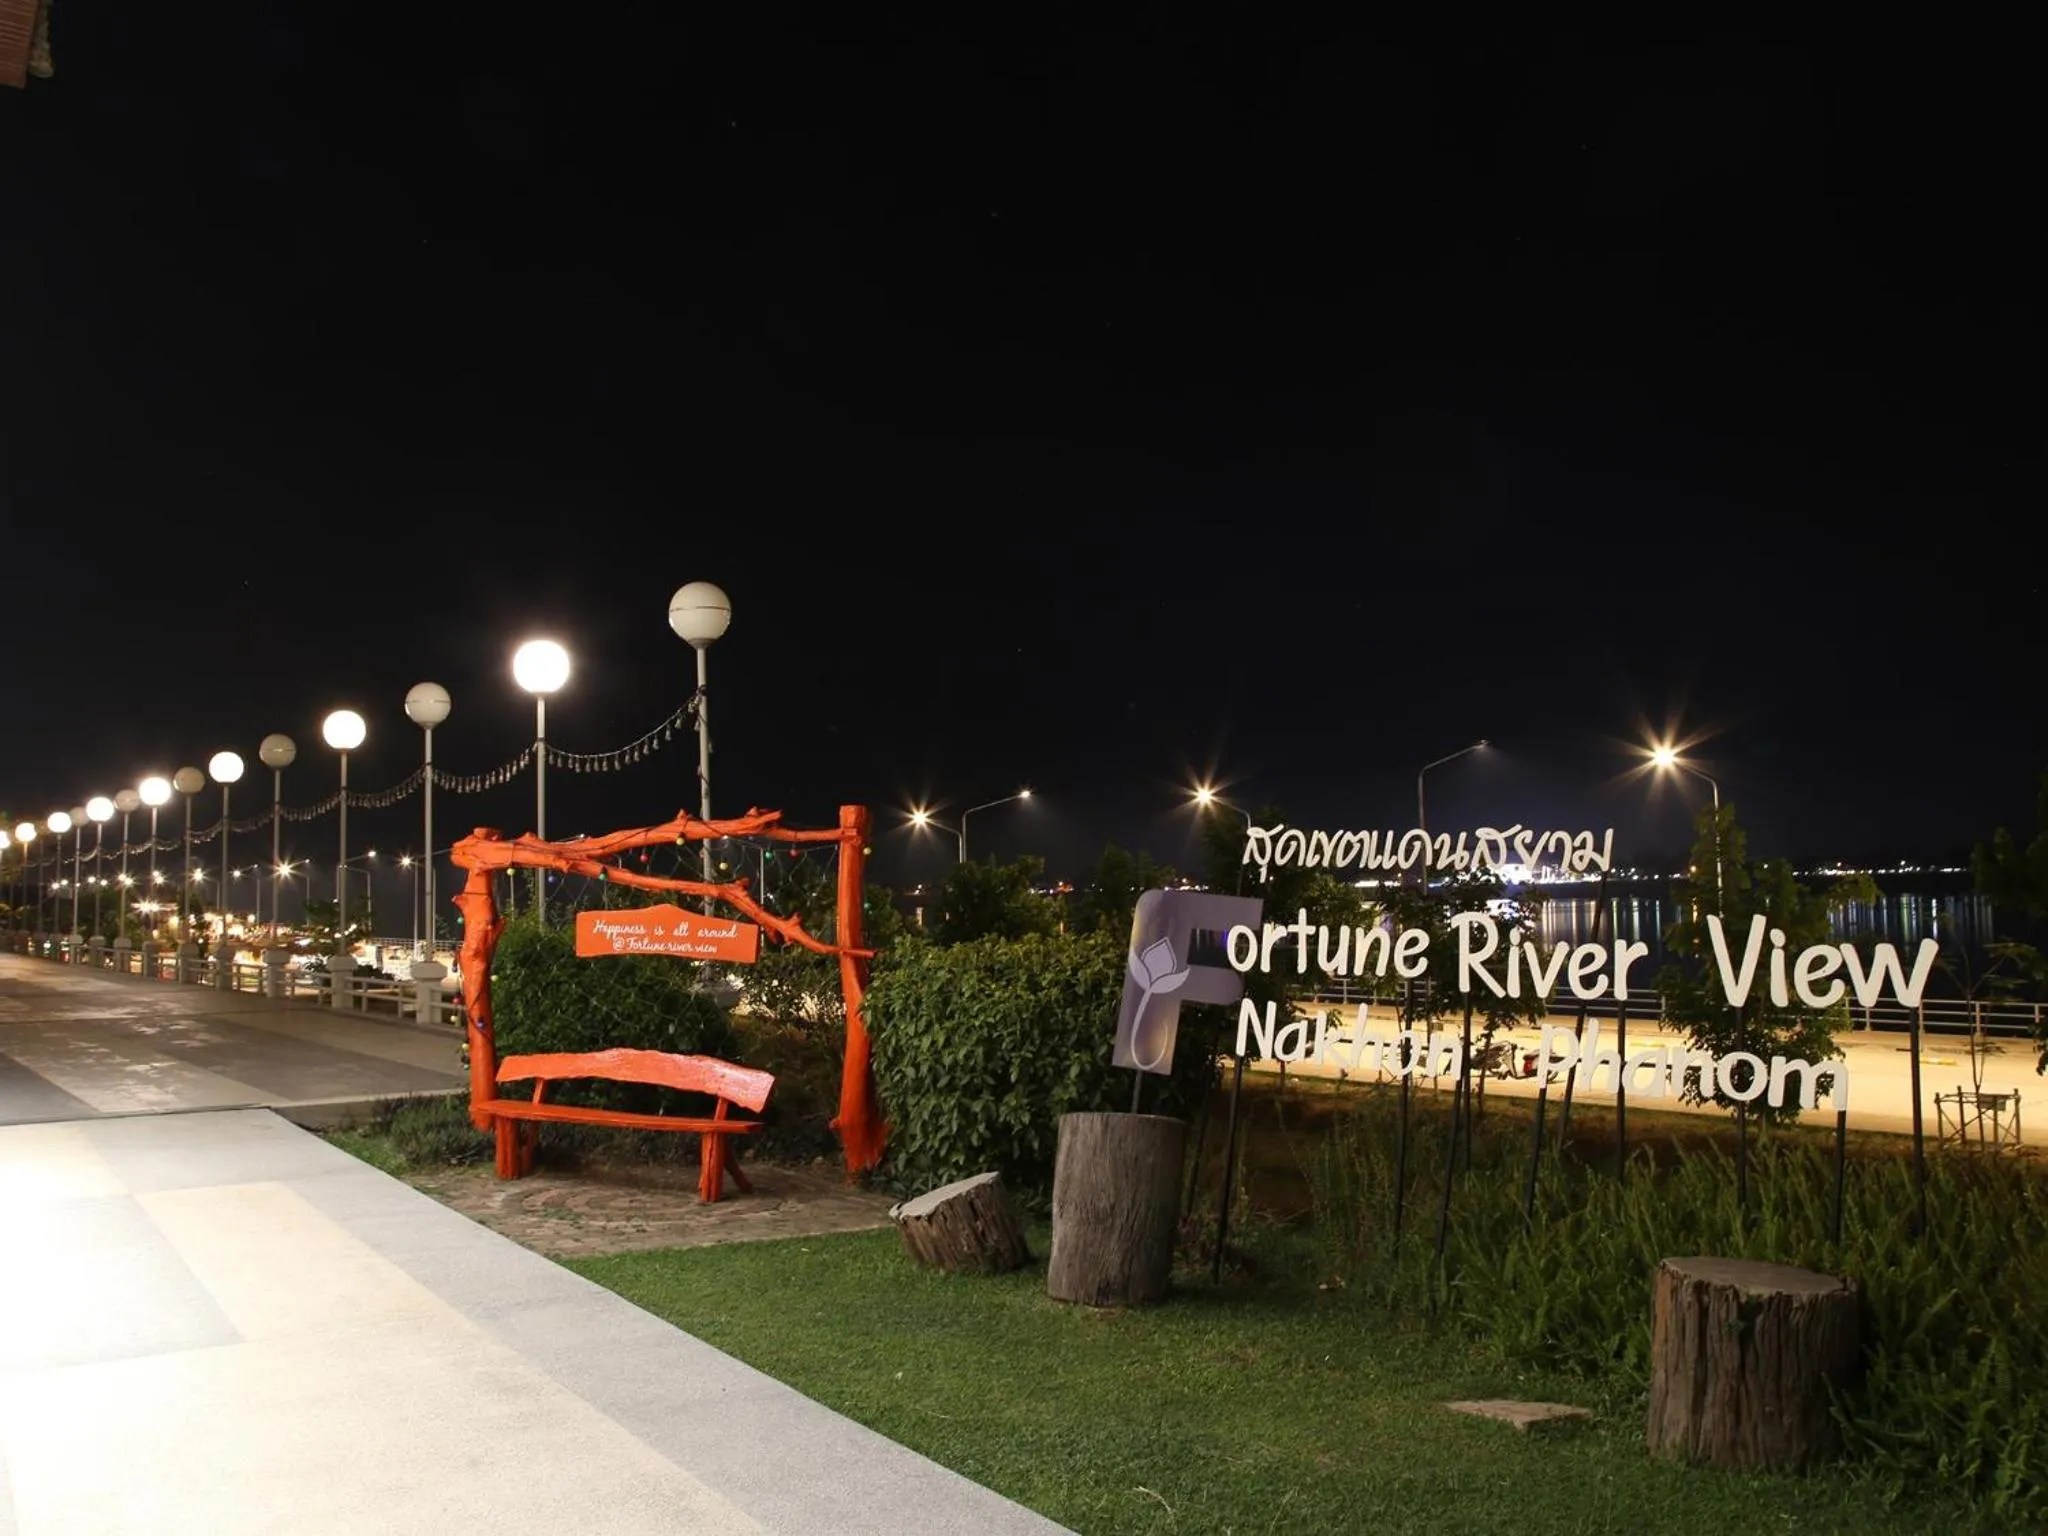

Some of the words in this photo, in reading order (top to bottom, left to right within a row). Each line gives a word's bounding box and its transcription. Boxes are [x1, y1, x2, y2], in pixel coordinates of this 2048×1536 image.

[1243, 824, 1614, 883] สุดเขตแดนสยาม
[593, 920, 645, 939] Happiness
[655, 925, 664, 935] is
[673, 922, 688, 936] all
[697, 924, 737, 938] around
[1451, 911, 1648, 1000] River
[1706, 914, 1938, 1008] View
[1235, 998, 1463, 1081] Nakhon
